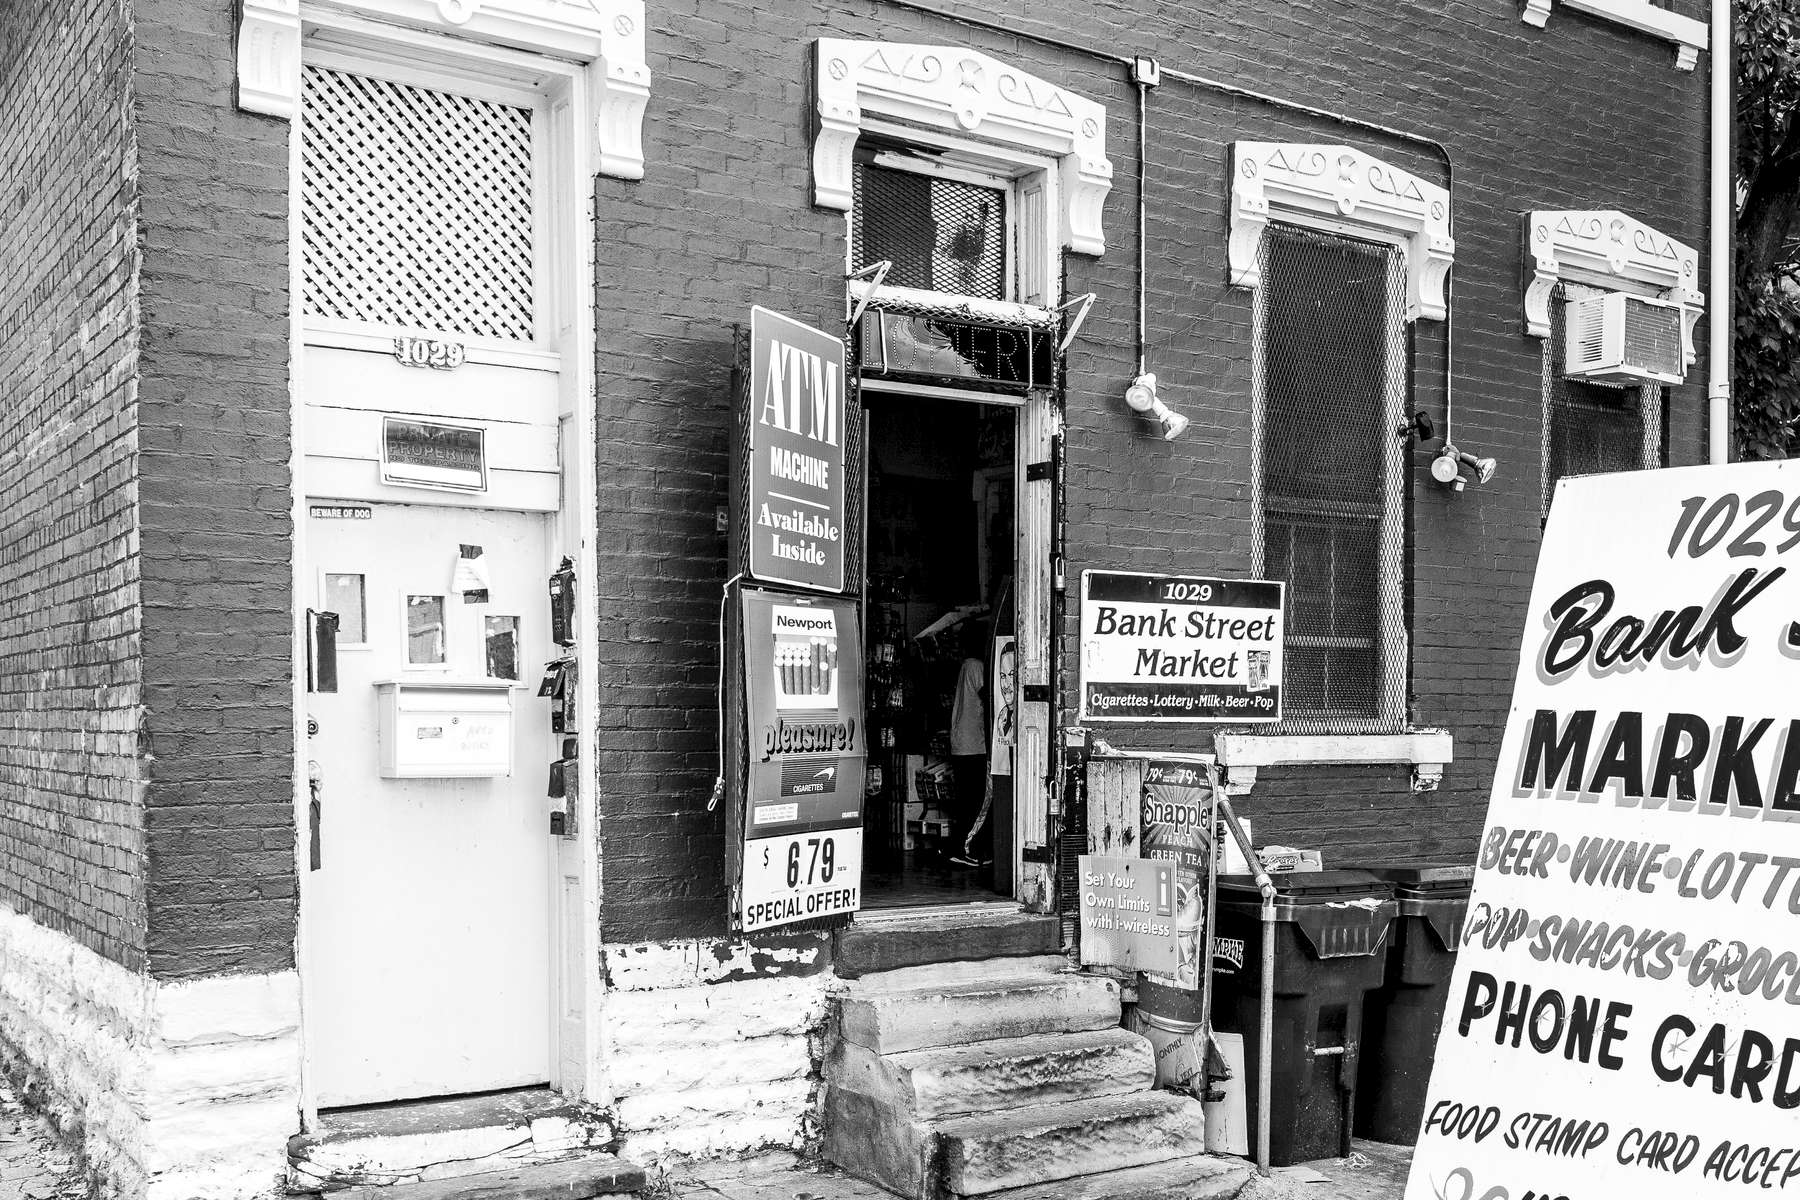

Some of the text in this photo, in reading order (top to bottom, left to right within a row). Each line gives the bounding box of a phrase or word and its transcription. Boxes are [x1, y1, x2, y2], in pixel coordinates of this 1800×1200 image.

[399, 337, 464, 368] 1029
[760, 339, 838, 447] ATM
[389, 441, 477, 463] PROPERTY
[770, 446, 829, 490] MACHINE
[310, 508, 371, 519] BEWARE OF DOG
[757, 502, 839, 542] Available
[771, 534, 826, 566] Inside
[1163, 583, 1213, 602] 1029
[777, 614, 833, 631] Newport
[1094, 606, 1276, 642] Bank Street
[1133, 648, 1239, 679] Market
[1091, 693, 1274, 710] Cigarettes Lottery Milk Beer Pop
[761, 717, 855, 763] pleasure!
[793, 783, 824, 793] CIGARETTES
[1144, 793, 1208, 836] Snapple
[1162, 834, 1193, 847] PEACH
[786, 838, 835, 889] 6.79
[1150, 849, 1202, 867] GREEN TEA
[1479, 826, 1558, 879] BEER
[1570, 835, 1670, 893] WINE
[1085, 871, 1135, 890] Set Your
[747, 887, 856, 926] SPECIAL OFFER!
[1085, 892, 1115, 909] Own
[1118, 895, 1151, 913] Limits
[1086, 915, 1170, 937] with i-wireless
[1462, 902, 1529, 952] POP
[1529, 914, 1687, 980] SNACKS
[1458, 970, 1633, 1071] PHONE
[1424, 1100, 1501, 1144] FOOD
[1503, 1112, 1609, 1159] STAMP
[1616, 1127, 1700, 1175] CARD
